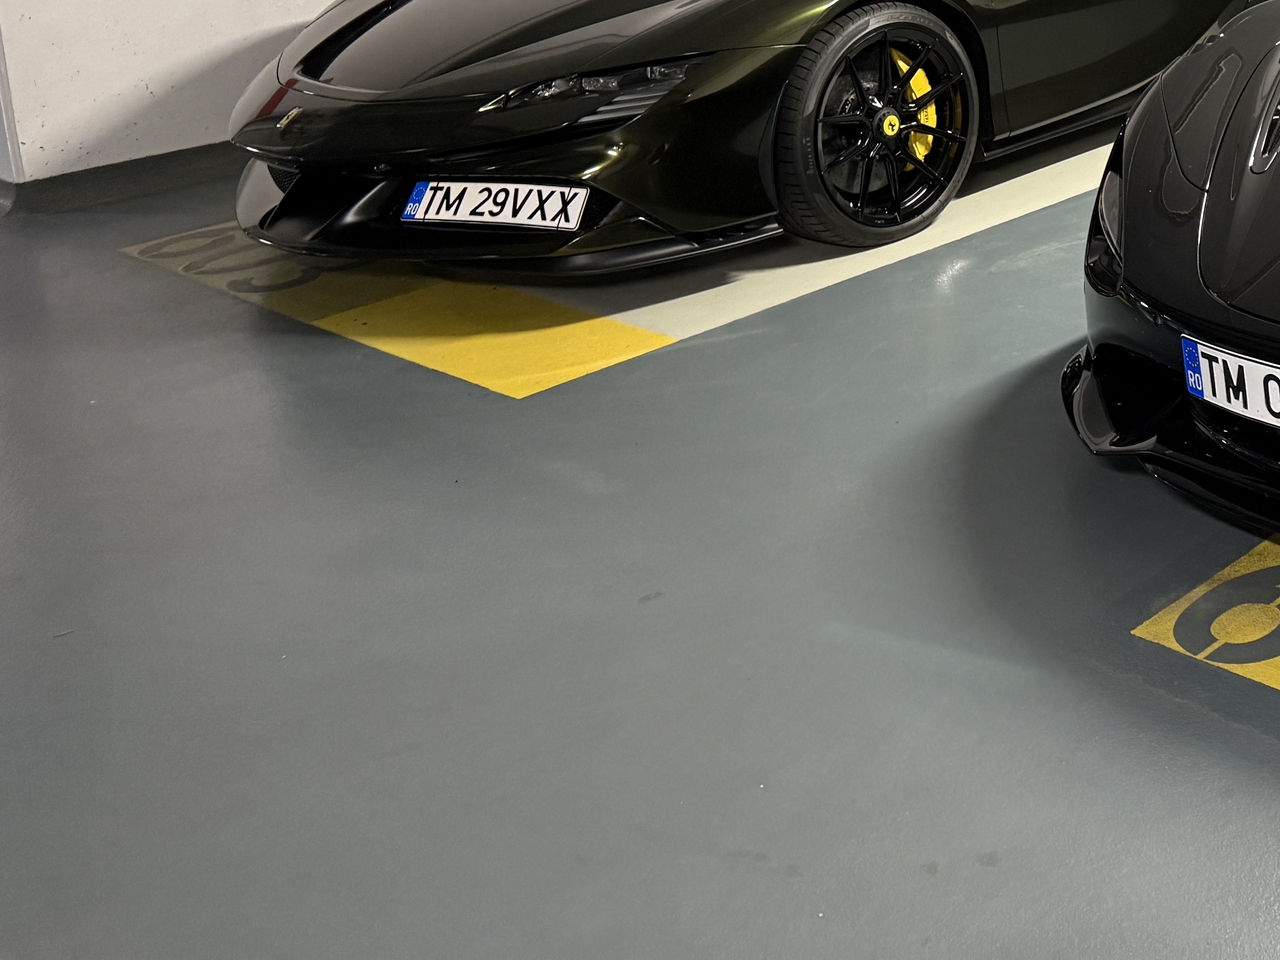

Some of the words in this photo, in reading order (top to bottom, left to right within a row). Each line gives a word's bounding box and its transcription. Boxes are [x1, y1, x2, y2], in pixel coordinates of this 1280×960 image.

[404, 203, 419, 216] RO
[424, 185, 468, 217] TM
[469, 187, 580, 224] 29VXX
[1187, 369, 1203, 391] RO
[1201, 350, 1249, 411] TM
